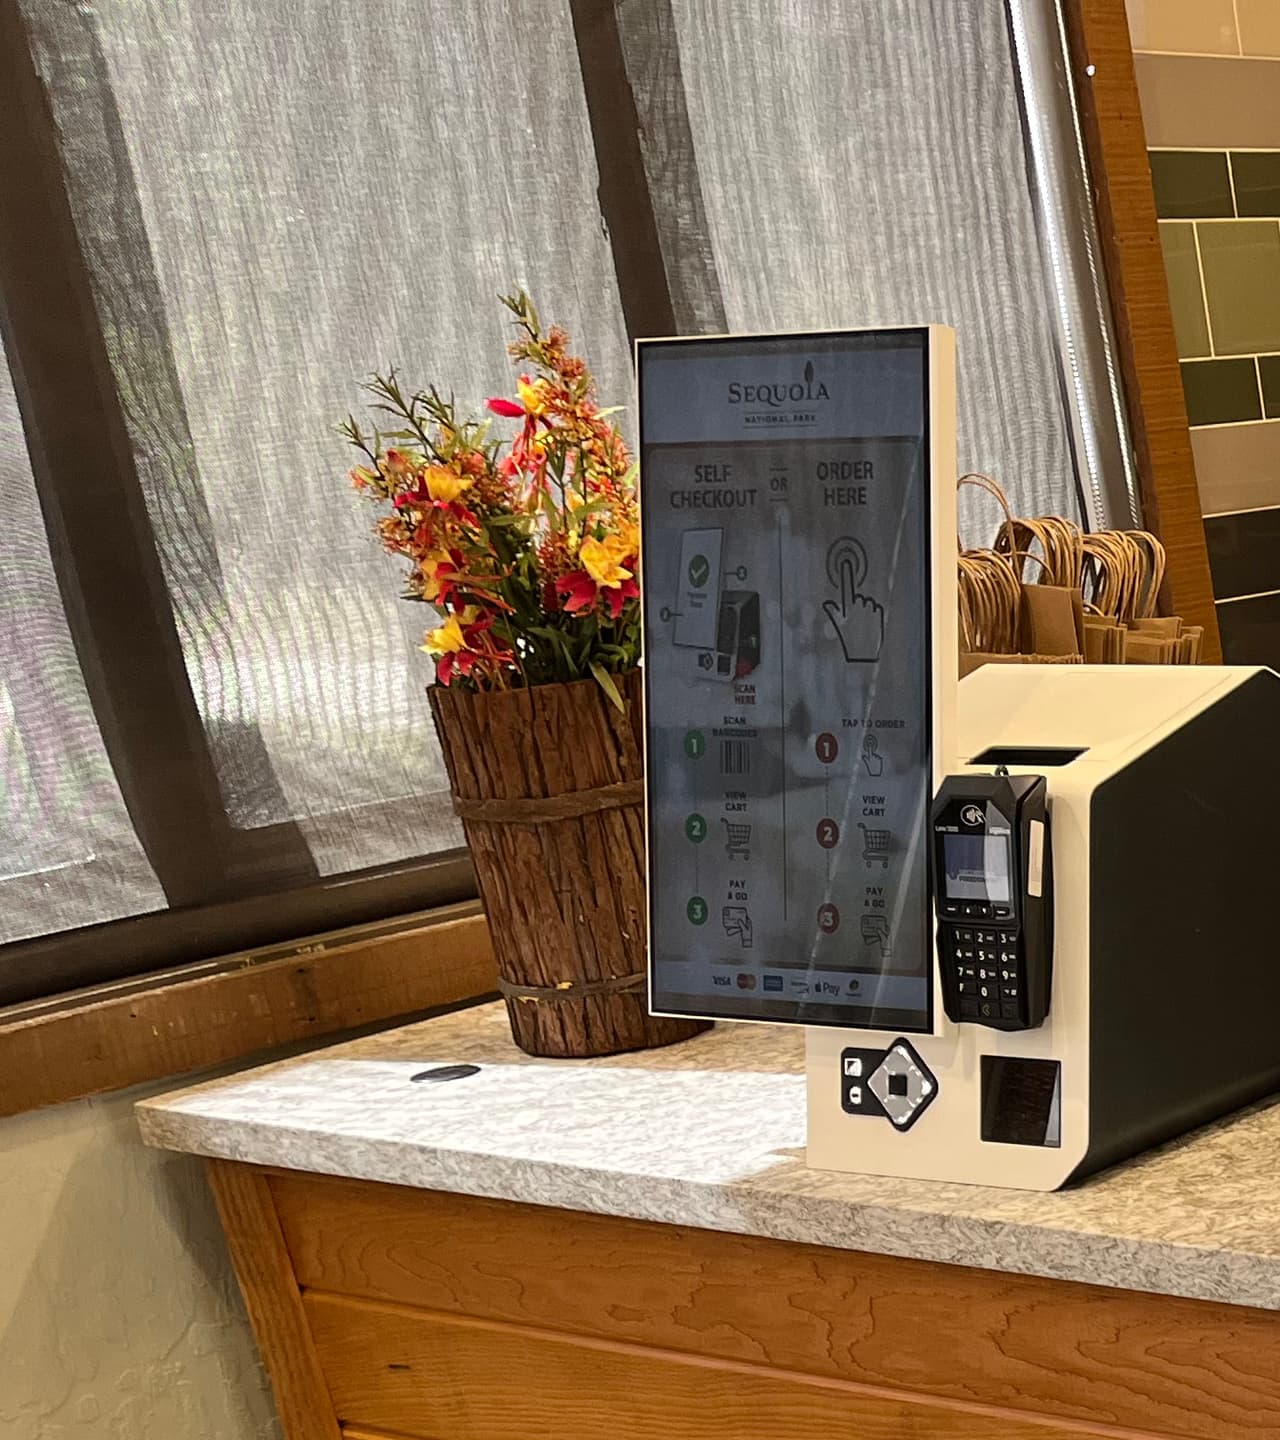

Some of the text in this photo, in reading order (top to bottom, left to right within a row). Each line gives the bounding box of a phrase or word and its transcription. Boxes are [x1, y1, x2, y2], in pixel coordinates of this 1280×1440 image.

[728, 376, 830, 407] SEQUOIA
[694, 465, 732, 483] SELF
[816, 462, 874, 481] ORDER
[770, 478, 788, 491] OR
[671, 490, 757, 508] CHECKOUT
[824, 487, 867, 506] HERE
[842, 719, 857, 727] TAP
[691, 739, 697, 753] 1
[823, 743, 830, 757] 1
[863, 796, 885, 804] VIEW
[725, 803, 746, 812] CART
[863, 808, 885, 816] CART
[692, 822, 700, 835] 2
[824, 827, 833, 841] 2
[729, 880, 746, 888] PAY
[866, 888, 883, 896] PAY
[823, 984, 840, 996] Pay
